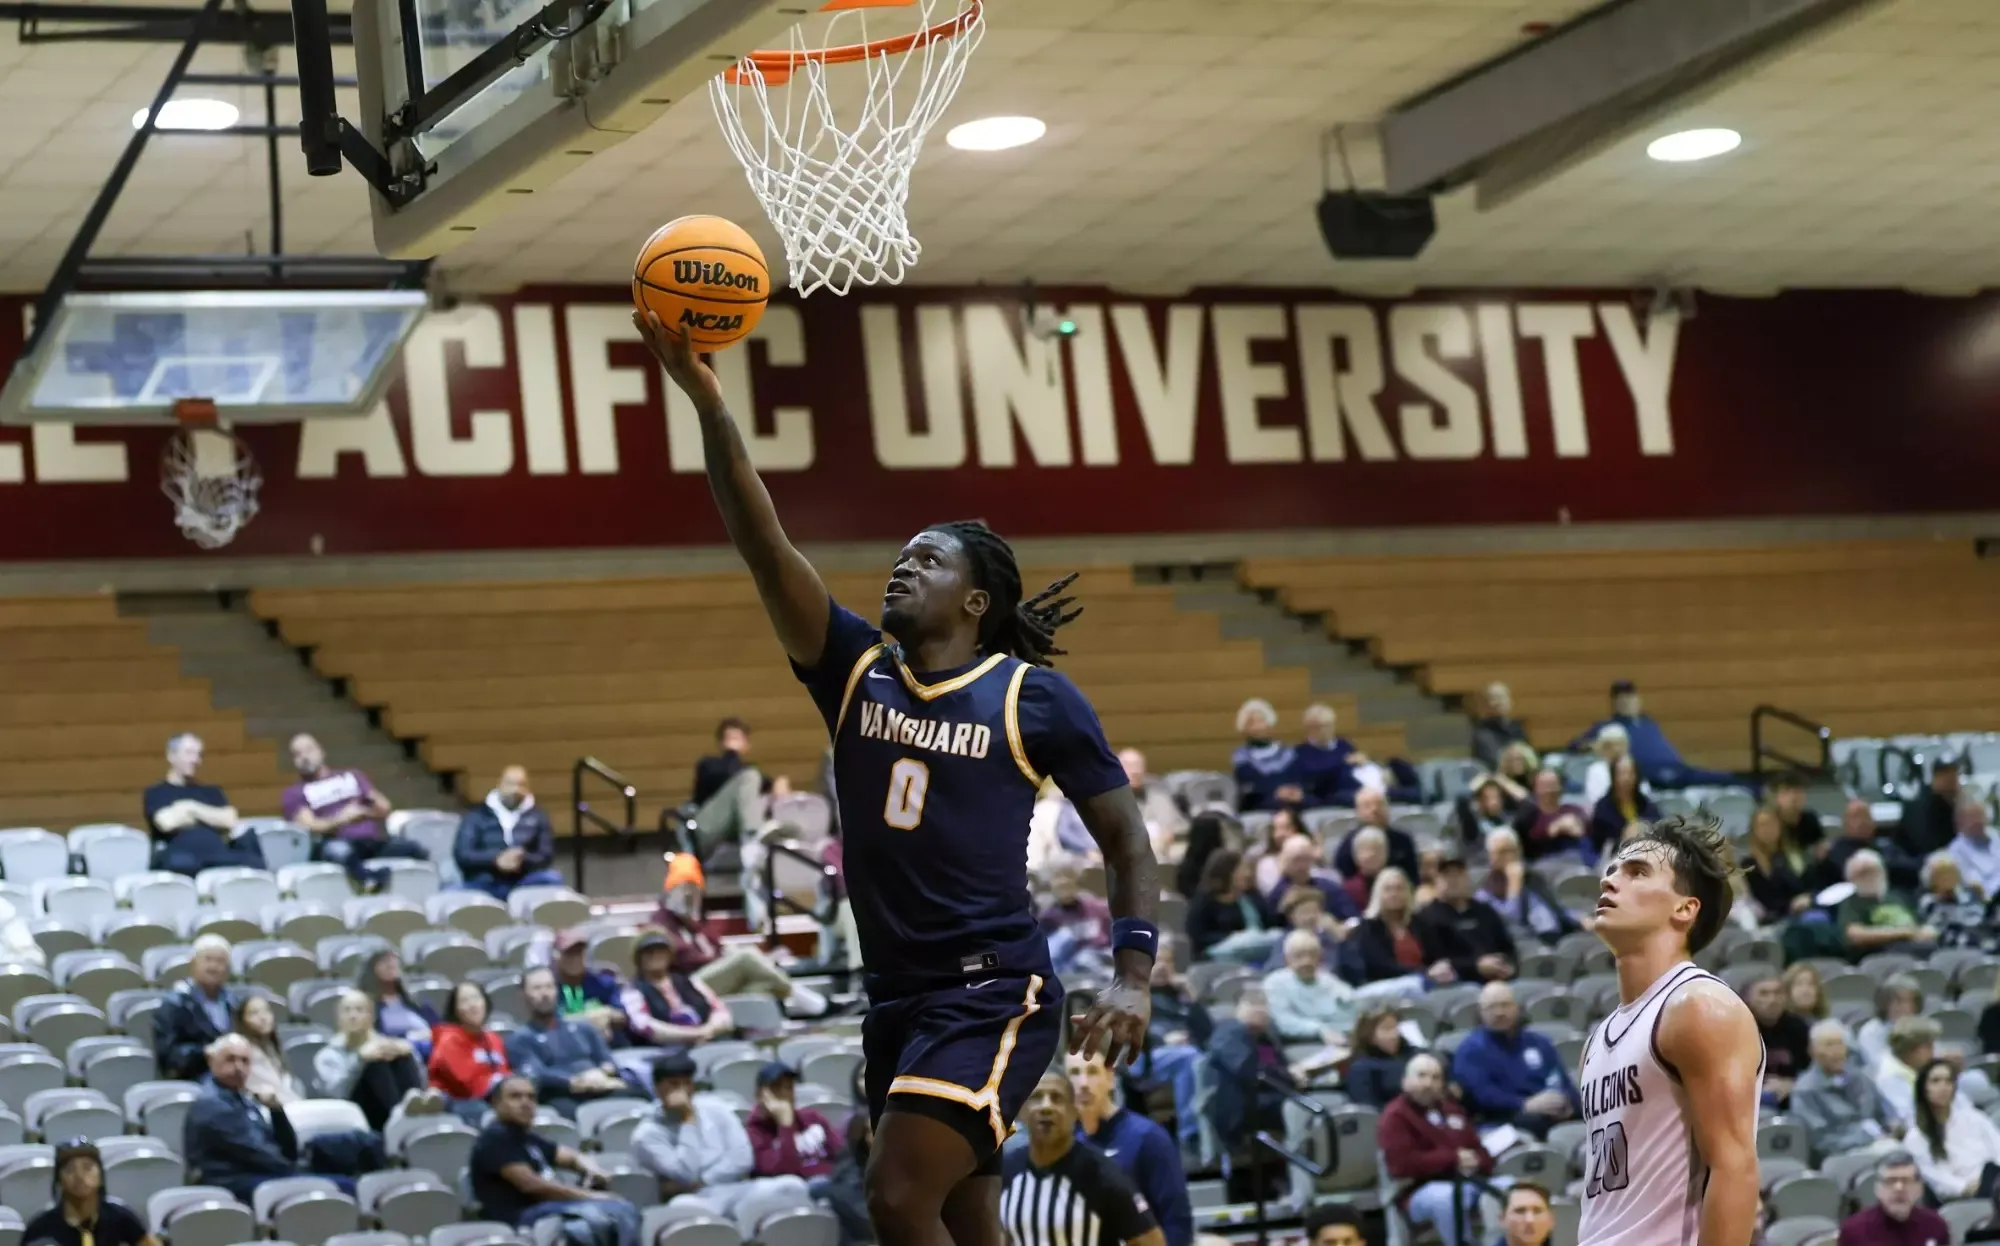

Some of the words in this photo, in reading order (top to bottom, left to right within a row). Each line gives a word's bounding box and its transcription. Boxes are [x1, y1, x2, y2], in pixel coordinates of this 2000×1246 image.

[673, 260, 760, 293] Wilson
[679, 307, 744, 331] NCAA
[859, 303, 1682, 470] UNIVERSITY
[860, 700, 991, 759] VANGUARD
[884, 757, 930, 831] 0
[1586, 1120, 1629, 1199] 20
